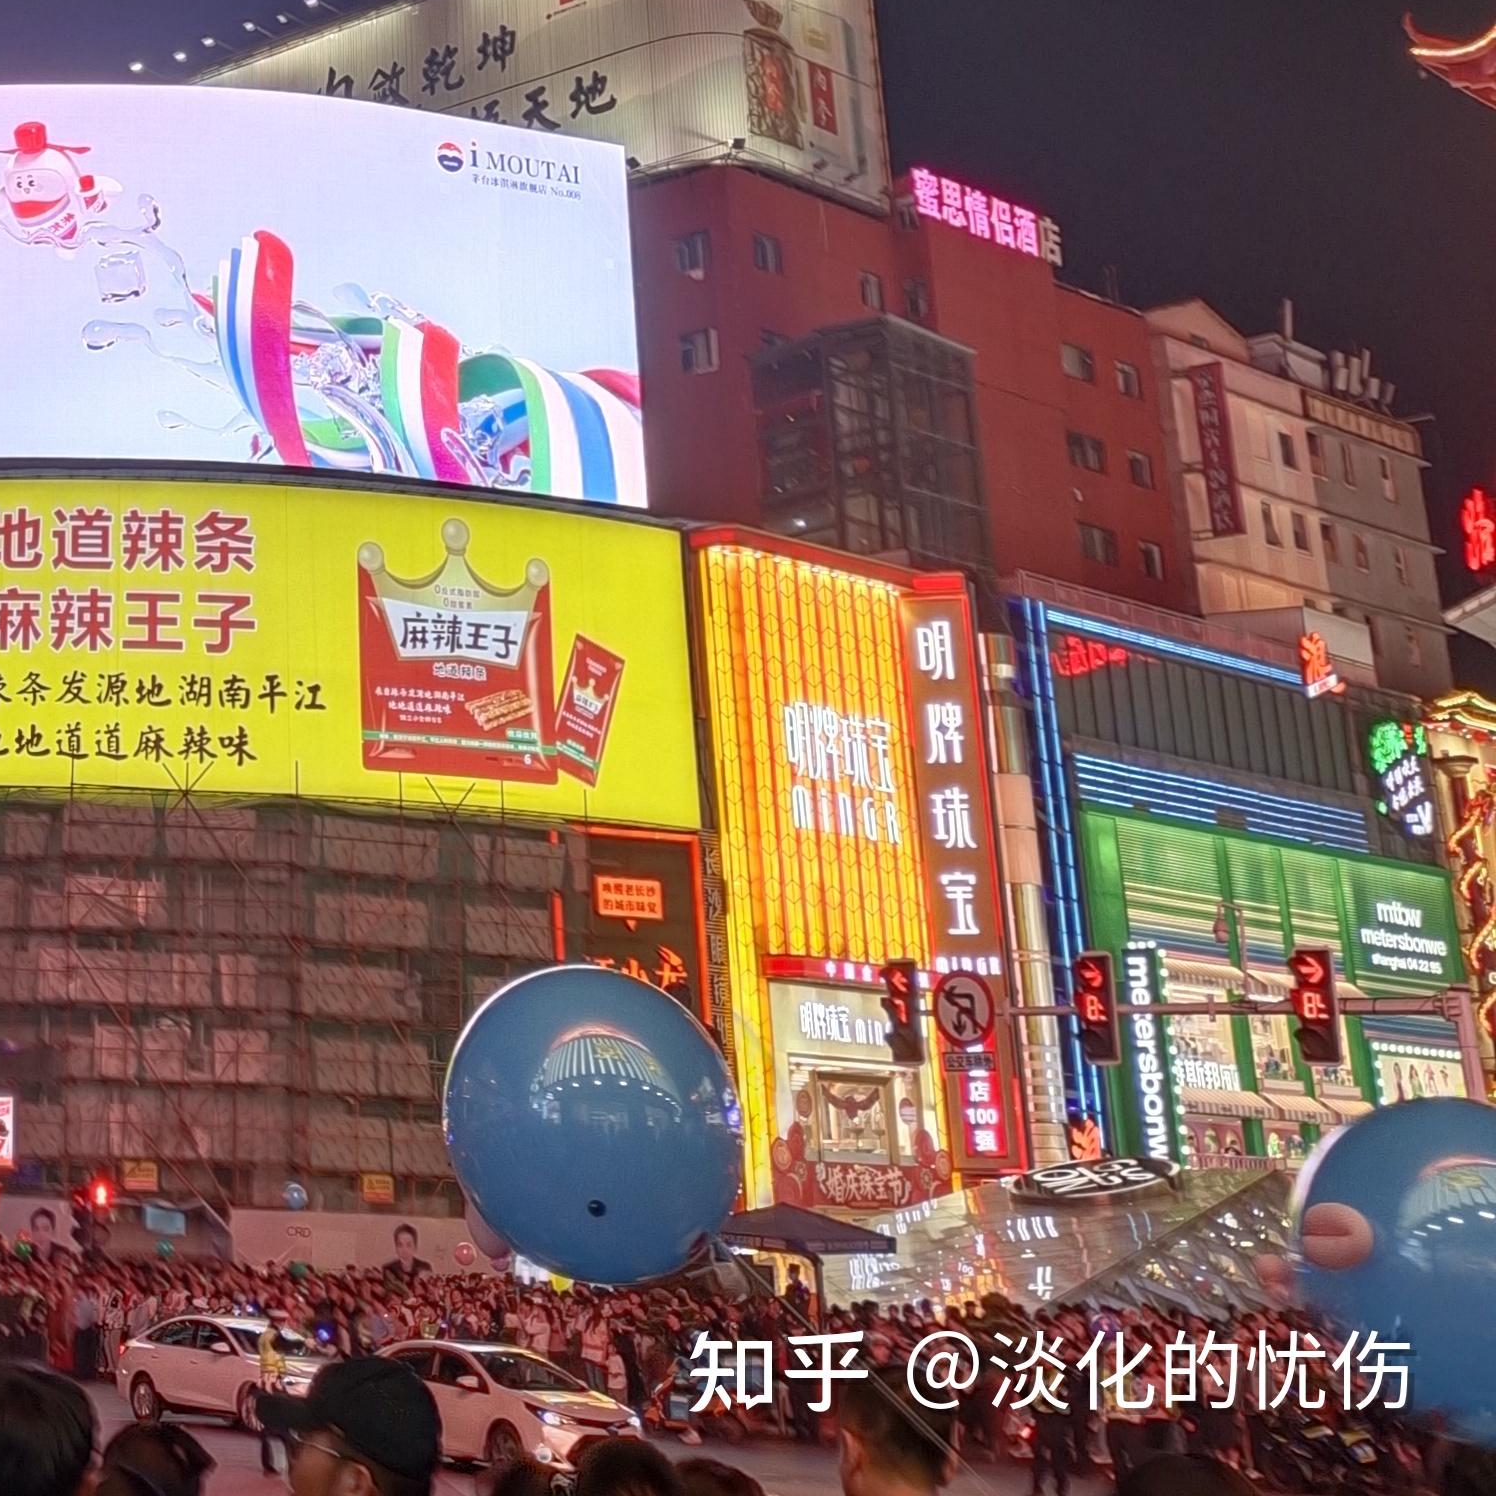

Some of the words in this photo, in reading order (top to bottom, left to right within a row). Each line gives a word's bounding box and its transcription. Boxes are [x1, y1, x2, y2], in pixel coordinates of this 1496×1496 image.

[486, 152, 581, 185] MOUTAI
[399, 611, 519, 660] 麻辣王子
[783, 701, 896, 794] 明牌珠宝
[916, 620, 981, 936] 明牌珠宝
[601, 882, 657, 897] 唤醒老长沙
[602, 898, 658, 914] 的城市味觉
[1360, 928, 1448, 957] metersbonwe
[799, 1002, 852, 1043] 明牌珠宝
